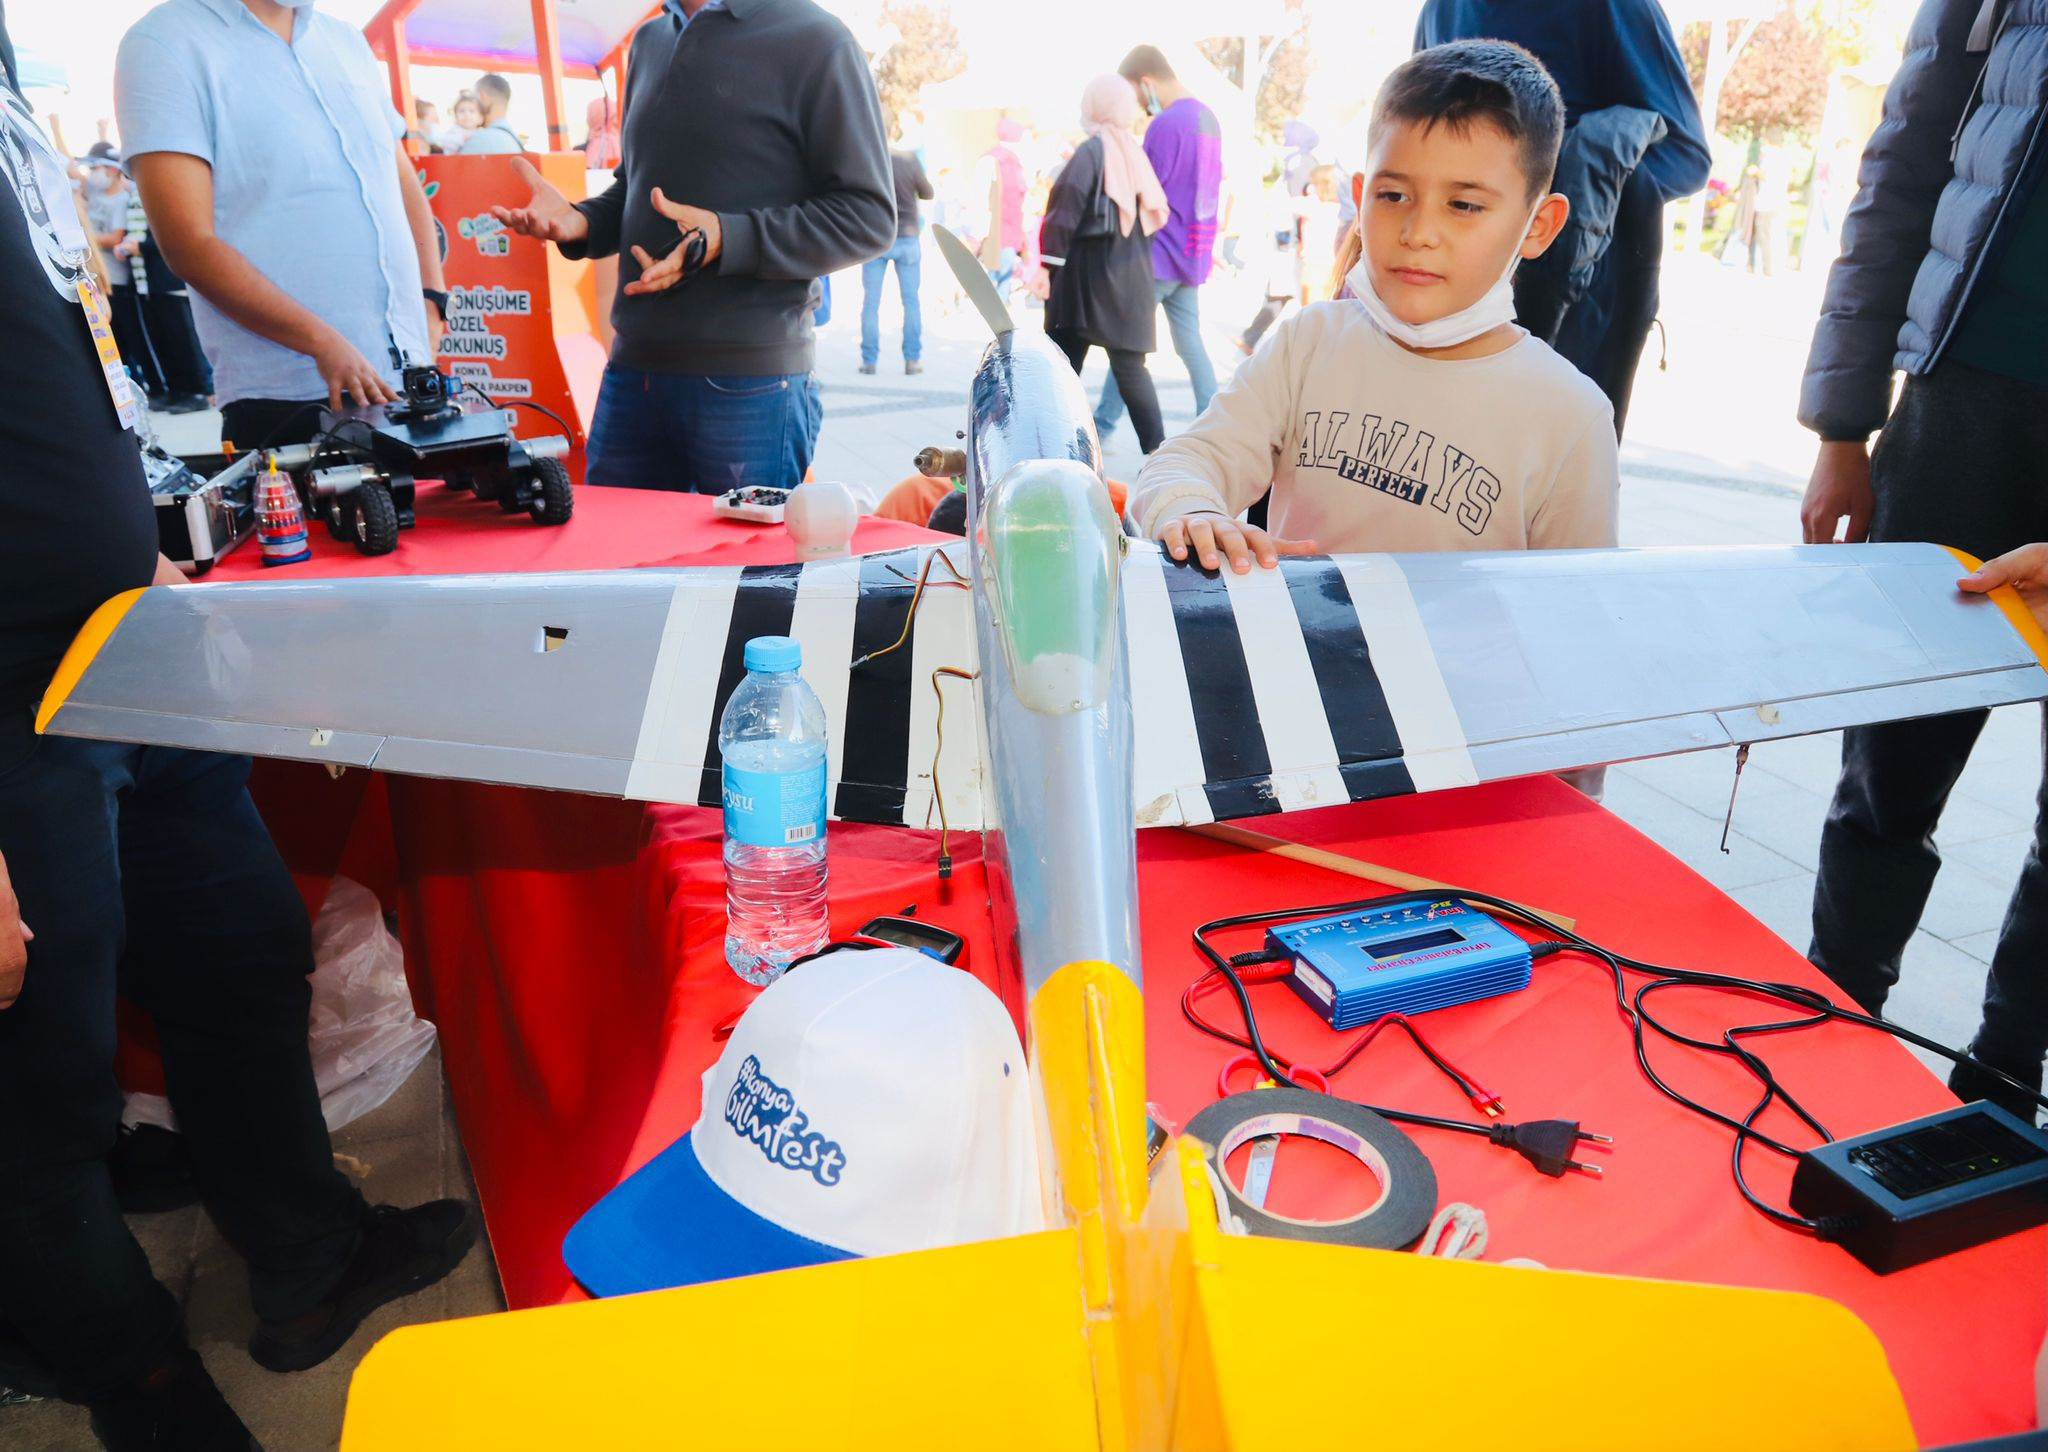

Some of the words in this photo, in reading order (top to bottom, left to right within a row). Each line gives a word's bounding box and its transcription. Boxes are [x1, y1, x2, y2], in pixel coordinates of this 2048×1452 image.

[455, 288, 527, 312] ÖNÜŞÜME
[455, 367, 488, 376] KONYA
[488, 383, 528, 393] PAKPEN
[1296, 411, 1501, 536] ALWAYS
[1341, 456, 1422, 502] PERFECT
[1415, 948, 1461, 962] Balance
[1366, 958, 1414, 972] Charger
